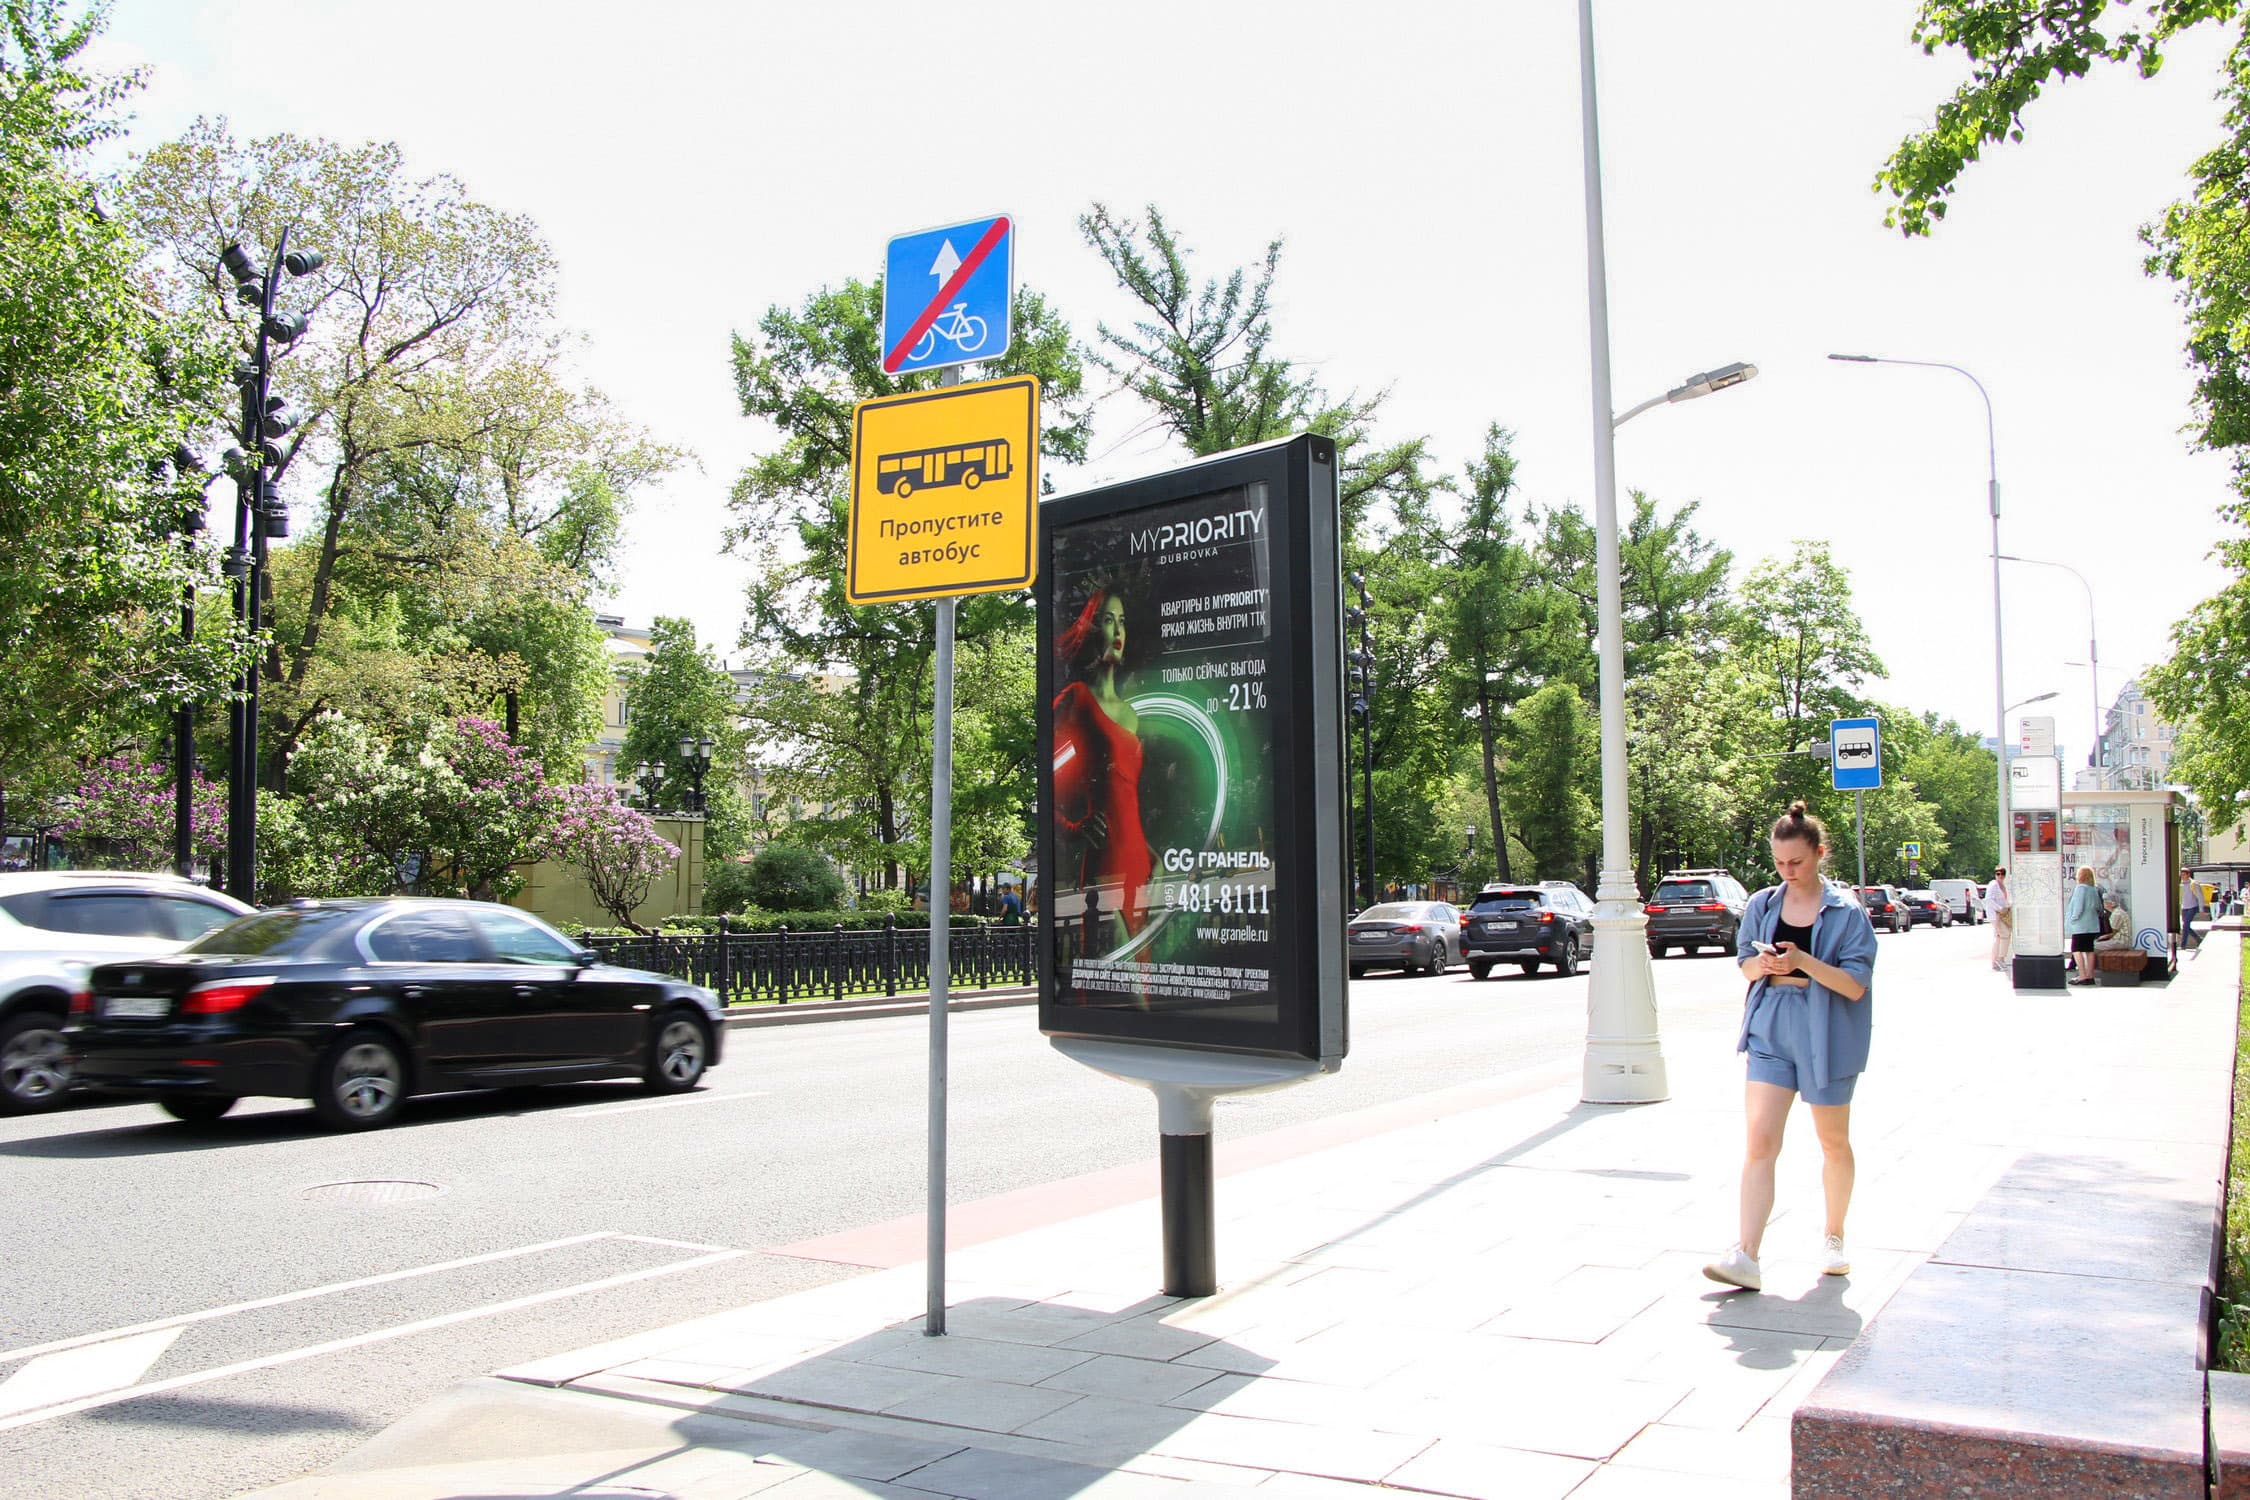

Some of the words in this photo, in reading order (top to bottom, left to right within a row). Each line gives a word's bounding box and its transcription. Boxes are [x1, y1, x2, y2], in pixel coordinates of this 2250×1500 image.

[880, 511, 1003, 541] Пропустите
[1130, 507, 1264, 555] MYPRIORITY
[899, 541, 980, 566] автобус
[1160, 547, 1218, 565] DUBROVKA
[1161, 598, 1202, 616] КВАРТИРЫ
[1204, 597, 1210, 611] В
[1161, 622, 1185, 638] ЯРКАЯ
[1186, 618, 1215, 635] ЖИЗНЬ
[1217, 613, 1248, 631] ВНУТРИ
[1250, 611, 1266, 627] ТТК
[1162, 667, 1193, 683] ТОЛЬКО
[1196, 662, 1228, 680] СЕЙЧАС
[1231, 659, 1266, 677] ВЫГОДА
[1206, 698, 1218, 715] ДО
[1222, 681, 1267, 711] -21%
[1198, 851, 1270, 868] ГРАНЕЛЬ
[1178, 884, 1269, 914] 481-8111
[1197, 925, 1268, 944] www.granelle.ru
